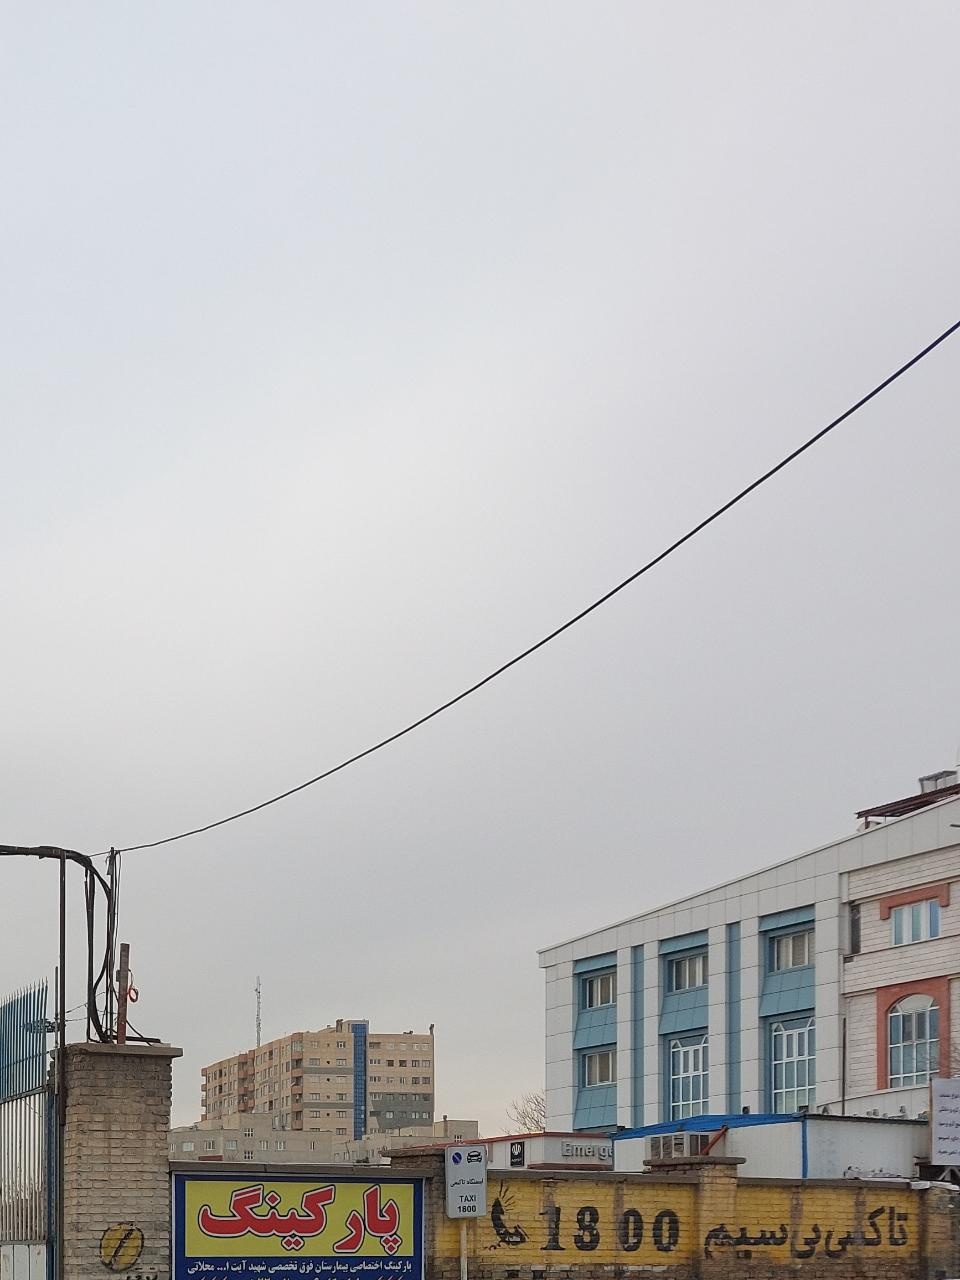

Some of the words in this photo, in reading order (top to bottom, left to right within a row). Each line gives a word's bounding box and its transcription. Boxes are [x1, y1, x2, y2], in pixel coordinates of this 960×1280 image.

[459, 1194, 477, 1203] TAXI
[457, 1205, 477, 1213] 1800
[198, 1183, 401, 1255] پارکینگ
[539, 1206, 680, 1252] 1800
[187, 1261, 215, 1275] محلاتی
[231, 1259, 248, 1274] آیت
[248, 1261, 267, 1274] شهید
[268, 1260, 298, 1274] تخصصی
[299, 1260, 314, 1274] فوق
[315, 1260, 349, 1274] بیمارستان
[350, 1260, 383, 1273] اختصاصی
